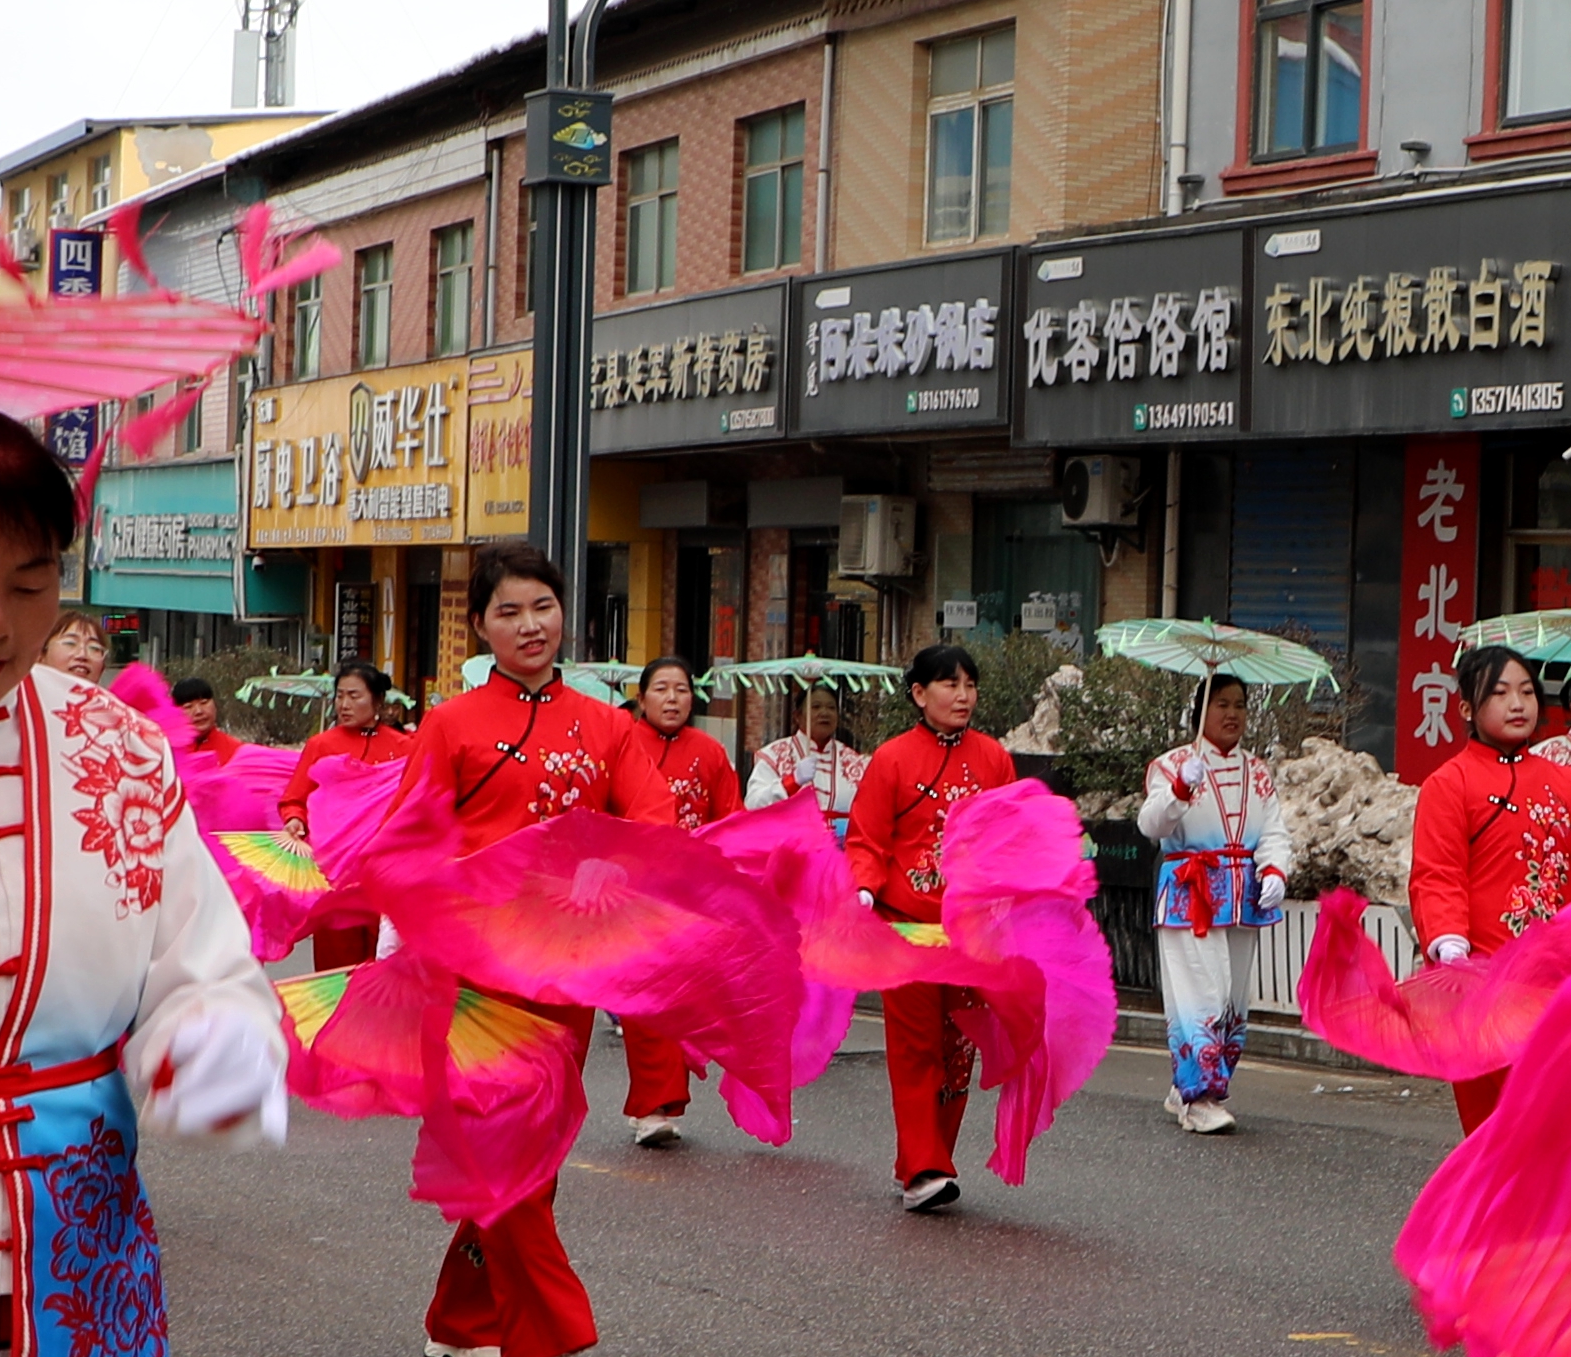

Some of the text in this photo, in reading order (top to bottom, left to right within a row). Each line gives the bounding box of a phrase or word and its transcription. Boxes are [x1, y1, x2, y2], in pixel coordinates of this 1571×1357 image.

[1024, 286, 1234, 389] 优客饸饹馆
[1262, 258, 1556, 366] 东北纯粮散白酒
[370, 382, 450, 470] 威华仕
[1148, 401, 1234, 429] 13649190541
[1471, 381, 1565, 415] 13571411305
[254, 432, 344, 510] 厨电卫浴
[1412, 459, 1465, 748] 老北京
